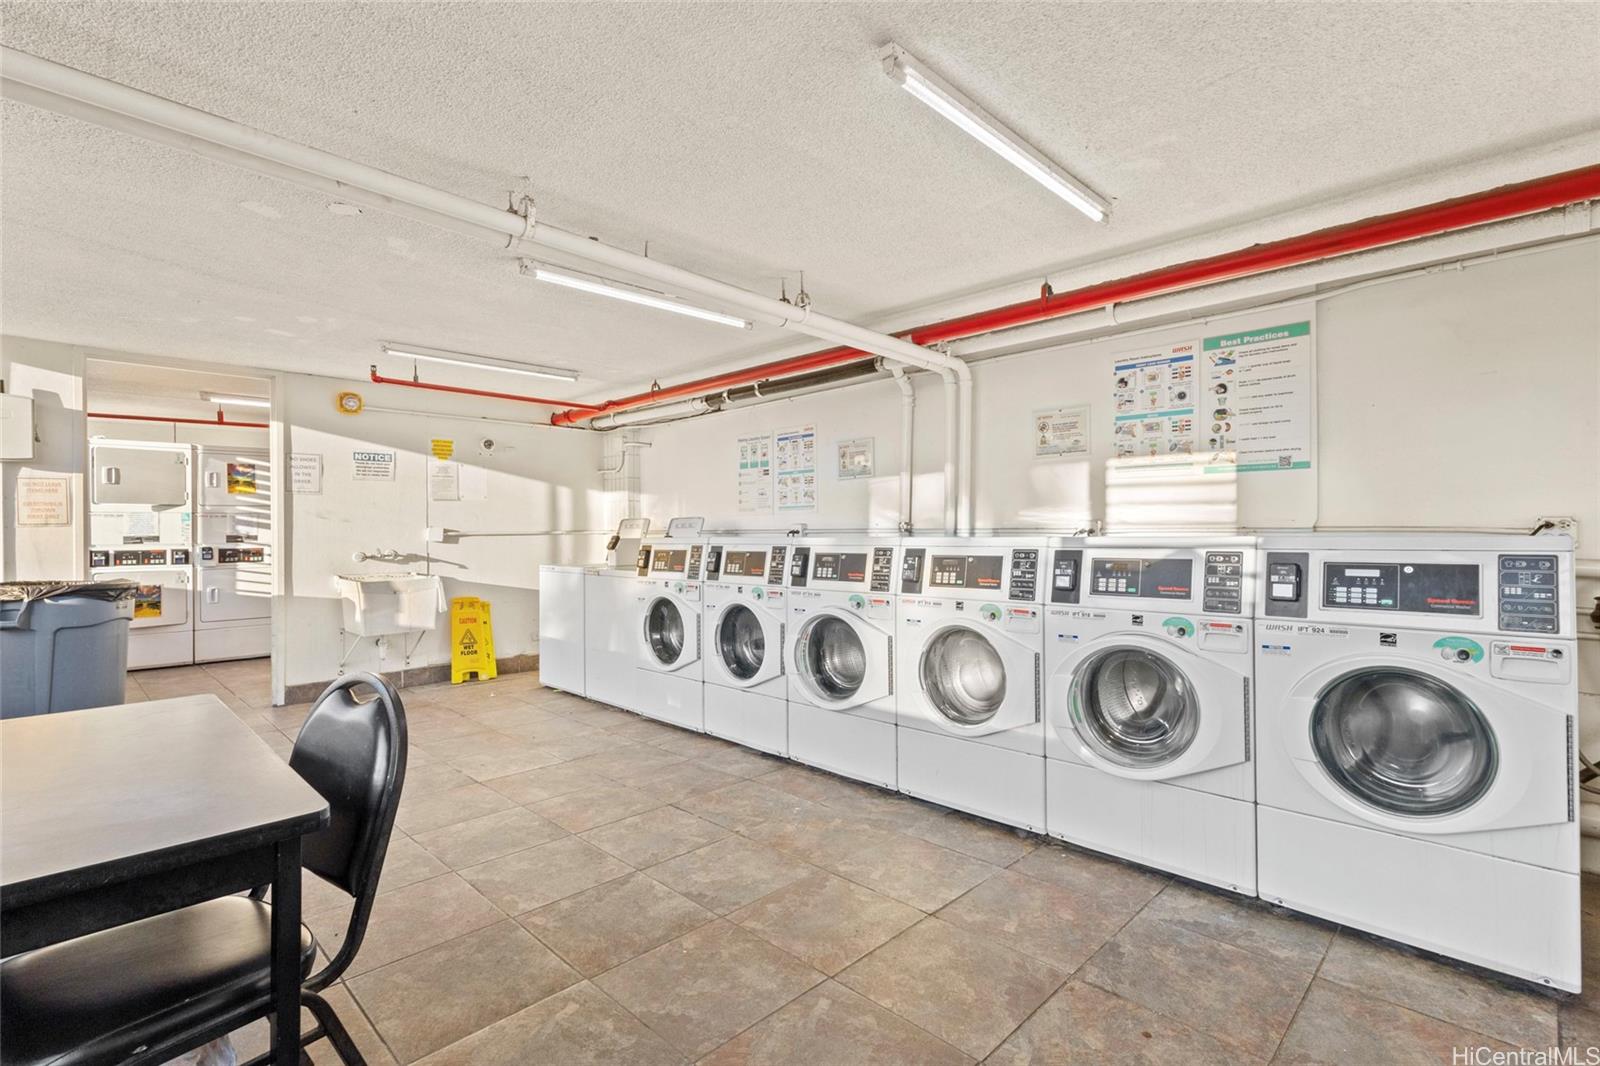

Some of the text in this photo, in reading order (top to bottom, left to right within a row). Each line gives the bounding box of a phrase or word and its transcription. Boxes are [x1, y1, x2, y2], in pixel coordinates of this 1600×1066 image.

[1220, 331, 1289, 347] Best Practices
[1172, 345, 1193, 353] WASH
[354, 453, 391, 461] NOTICE
[1265, 624, 1293, 632] WASH
